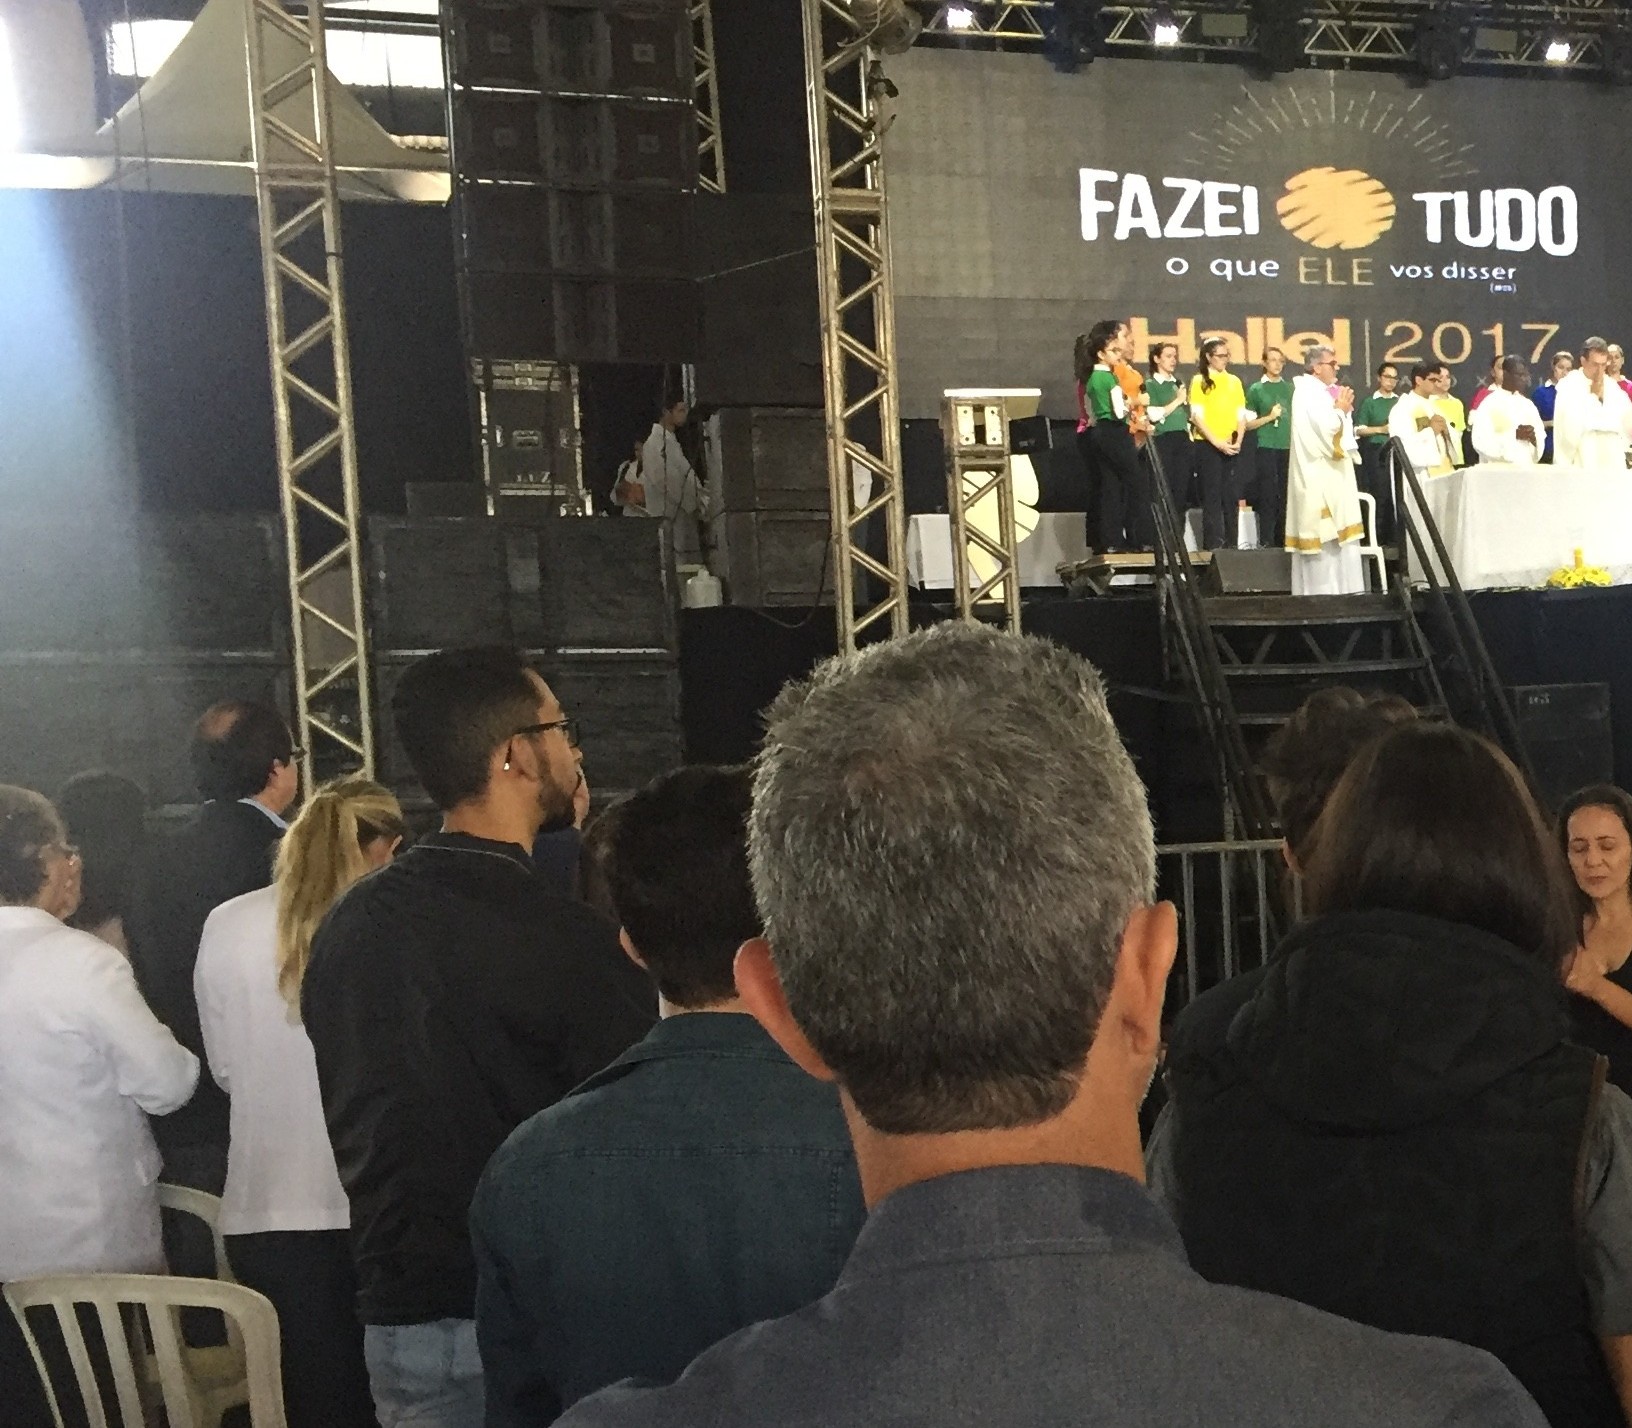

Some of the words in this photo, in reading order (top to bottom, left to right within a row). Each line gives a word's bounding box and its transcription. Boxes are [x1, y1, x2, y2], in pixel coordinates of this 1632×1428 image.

[1079, 168, 1260, 241] FAZEI
[1412, 185, 1578, 256] TUDO
[1166, 257, 1189, 275] o
[1209, 258, 1280, 281] que
[1299, 256, 1375, 286] ELE
[1389, 264, 1434, 279] vos
[1441, 261, 1517, 280] disser
[1384, 320, 1561, 364] 2017
